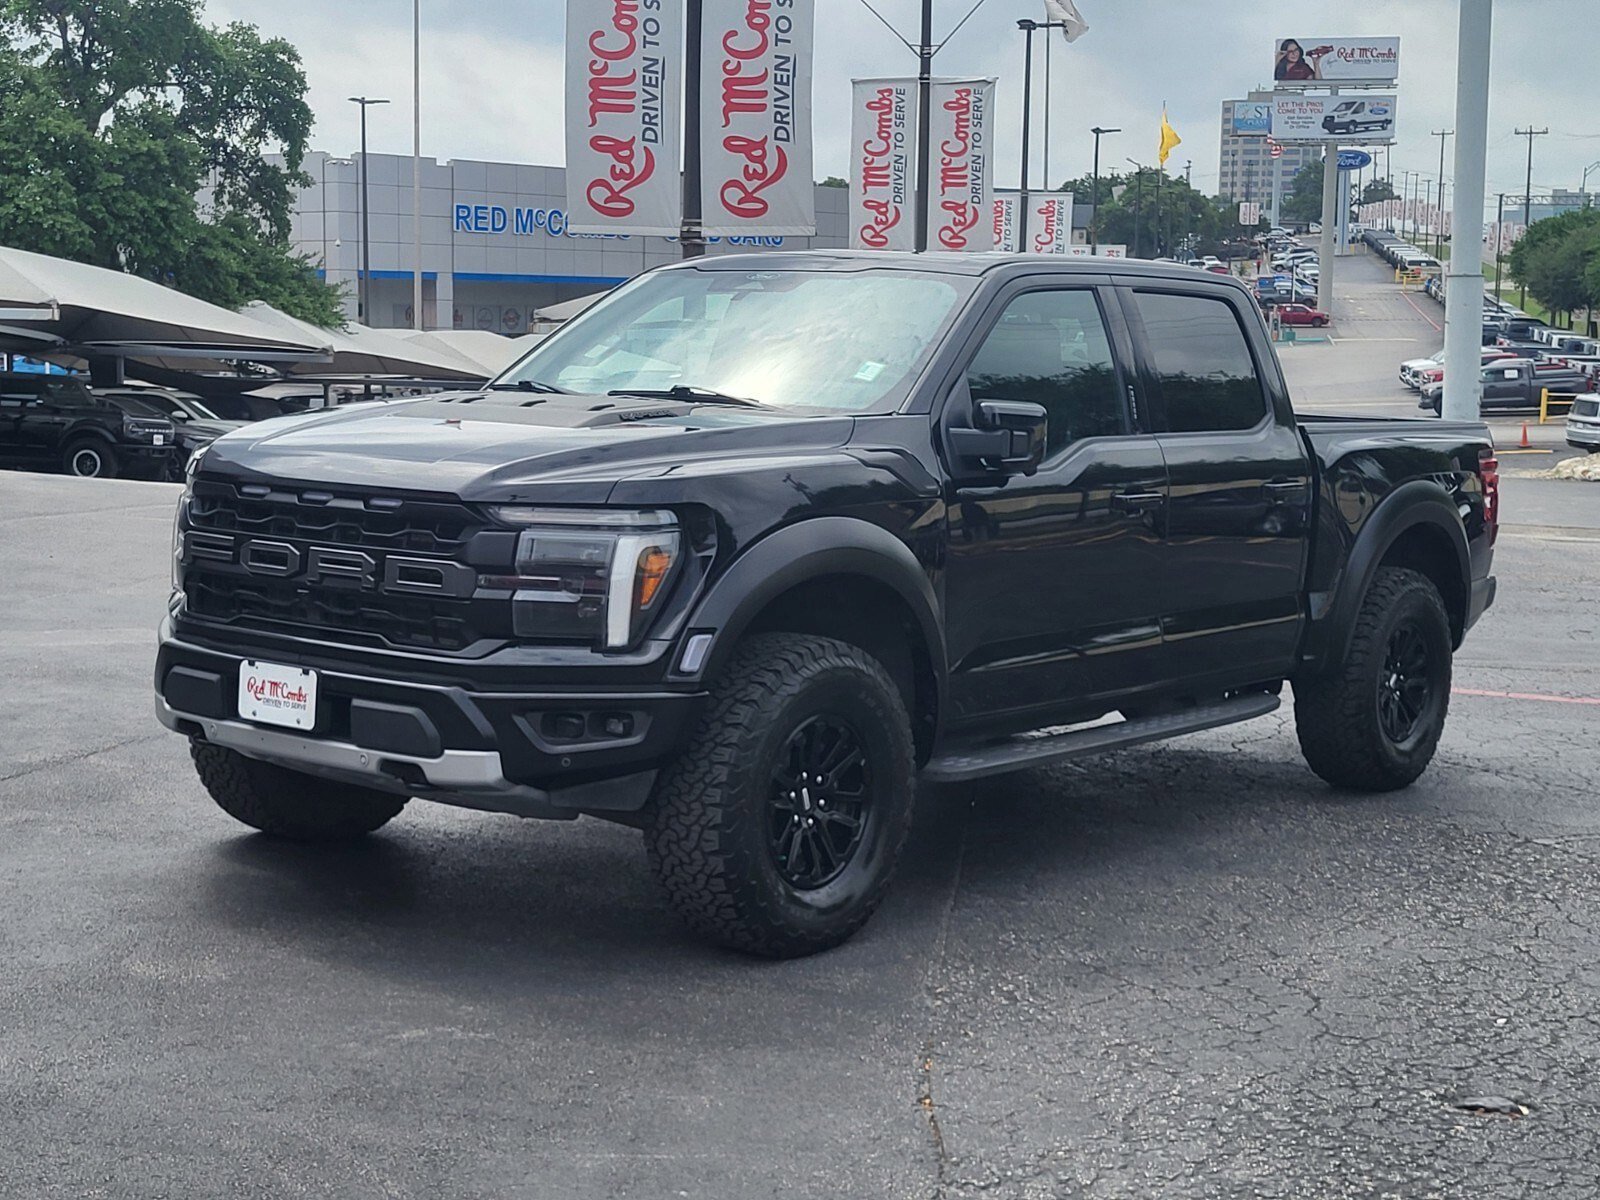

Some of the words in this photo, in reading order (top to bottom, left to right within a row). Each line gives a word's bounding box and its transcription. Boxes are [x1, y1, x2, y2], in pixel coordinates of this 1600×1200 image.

[643, 17, 661, 49] TO
[775, 15, 793, 47] TO
[1337, 47, 1355, 62] Red
[1356, 47, 1397, 59] McCombs
[642, 56, 661, 144] DRIVEN
[774, 54, 792, 143] DRIVEN
[894, 87, 906, 129] SERVE
[971, 88, 984, 129] SERVE
[863, 87, 893, 195] McCombs
[894, 131, 906, 150] TO
[941, 87, 972, 196] McCombs
[971, 132, 983, 151] TO
[586, 135, 655, 218] Red
[720, 135, 788, 218] Red
[892, 154, 905, 204] DRIVEN
[971, 154, 983, 205] DRIVEN
[454, 203, 507, 234] RED
[860, 200, 900, 248] Red
[938, 200, 979, 249] Red
[1005, 199, 1013, 227] SERVE
[1055, 199, 1065, 227] SERVE
[1004, 228, 1012, 242] TO
[1055, 228, 1063, 242] TO
[181, 530, 477, 603] FORD
[247, 676, 266, 701] Red
[267, 679, 308, 703] McCombs
[263, 697, 282, 708] DRIVEN
[283, 700, 291, 708] TO
[291, 701, 307, 711] SERVE
